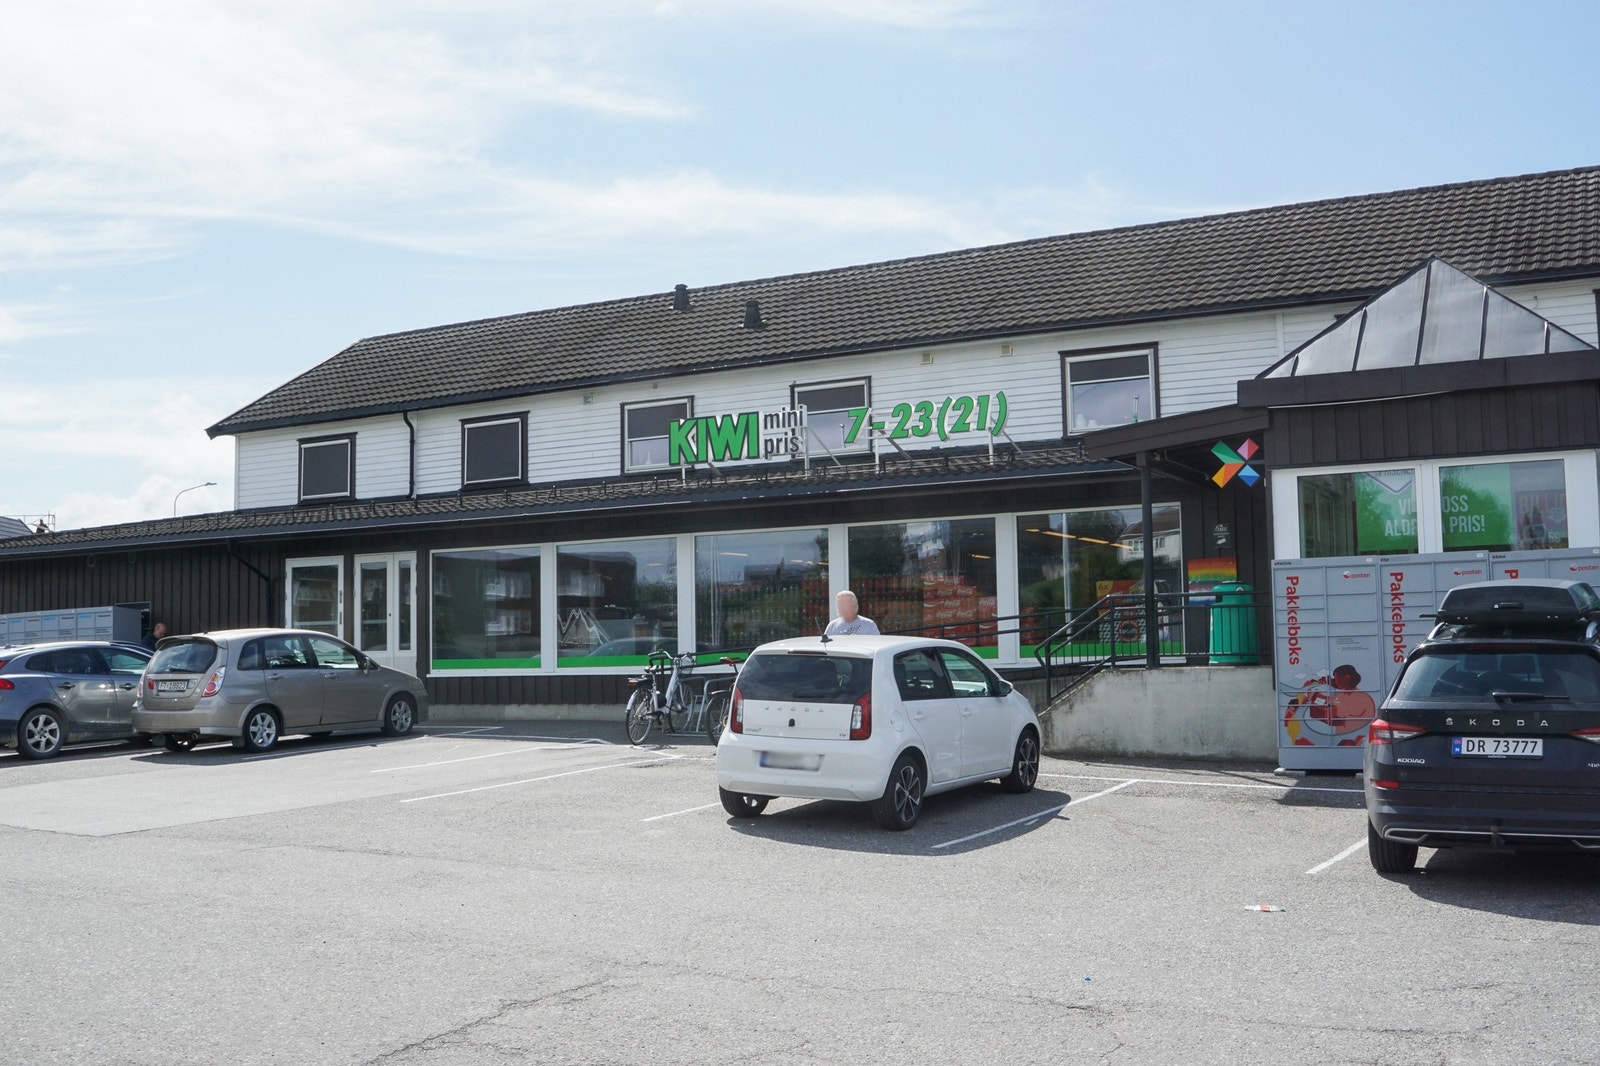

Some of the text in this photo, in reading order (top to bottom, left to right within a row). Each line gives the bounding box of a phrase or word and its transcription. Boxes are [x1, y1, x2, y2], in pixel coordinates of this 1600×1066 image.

[763, 404, 805, 430] mini
[668, 411, 760, 466] KIWI
[763, 434, 801, 460] pris
[1441, 495, 1469, 513] OSS
[1449, 515, 1486, 533] PRIS!
[1285, 576, 1302, 666] Pakkeboks
[1389, 572, 1407, 663] Pakkeboks
[1466, 739, 1538, 754] DR 73777
